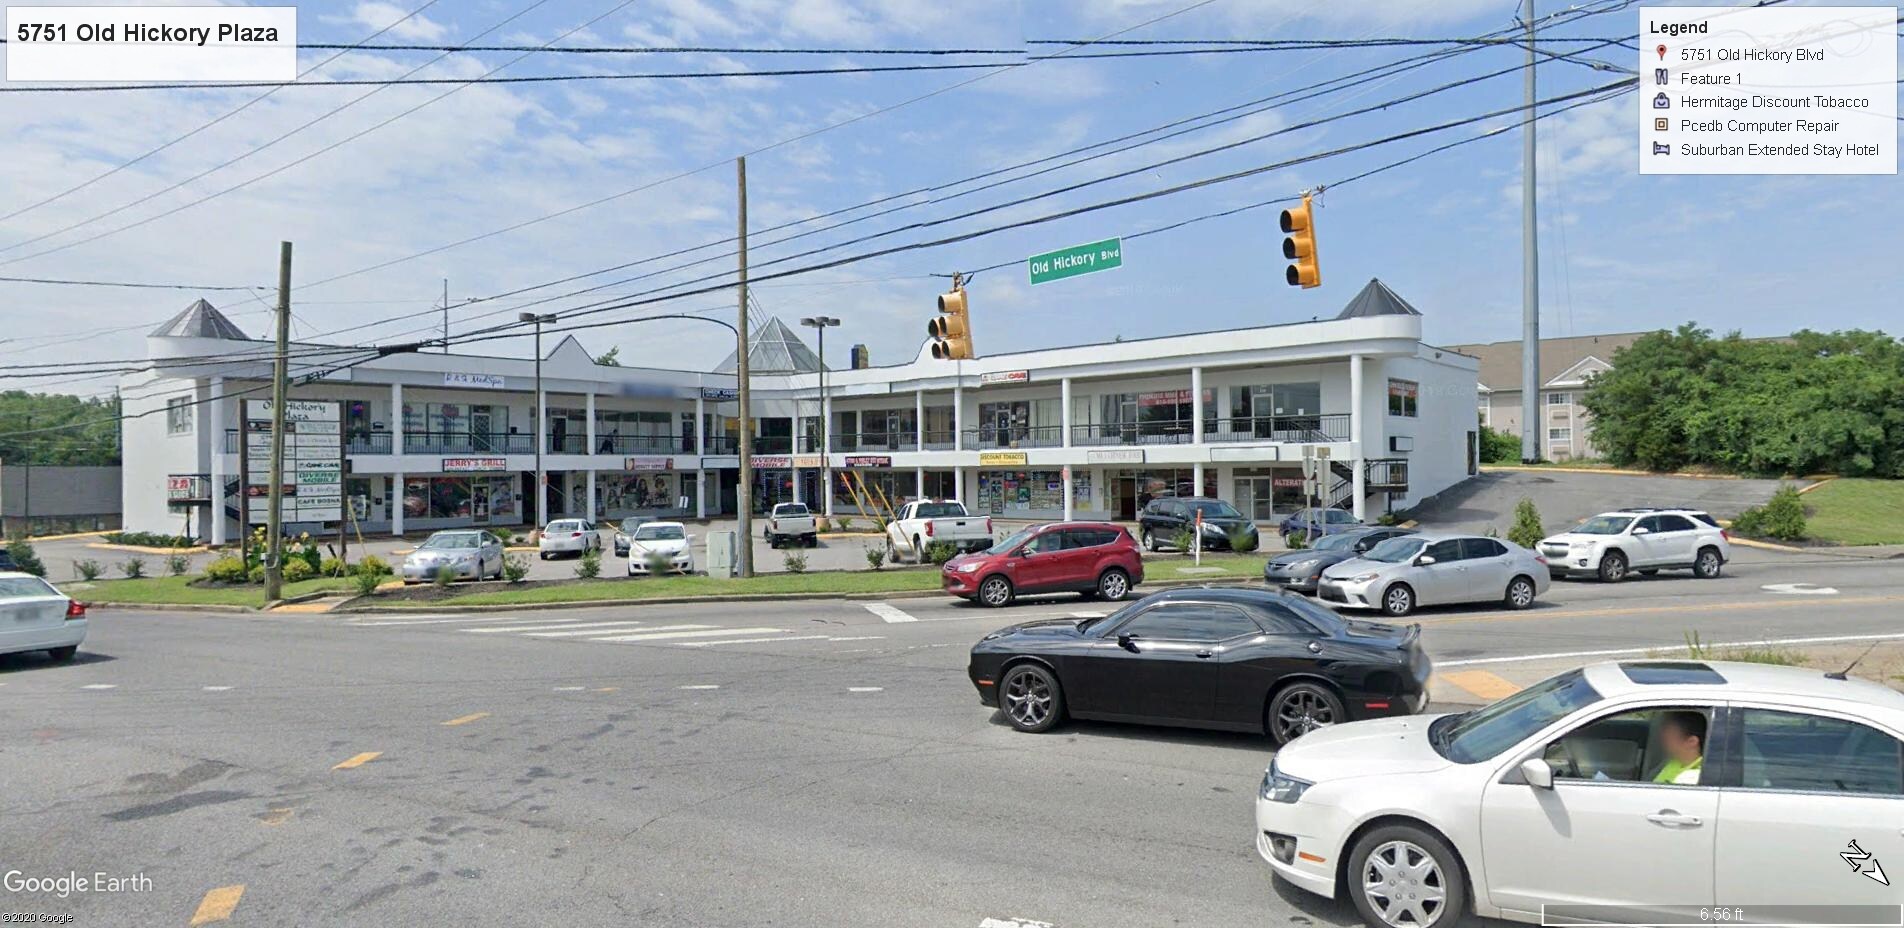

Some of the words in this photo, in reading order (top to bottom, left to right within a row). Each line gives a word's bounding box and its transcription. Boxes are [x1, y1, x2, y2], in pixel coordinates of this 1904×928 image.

[1032, 260, 1049, 275] Old
[1053, 252, 1095, 270] Hickory
[1101, 249, 1119, 260] Blvd
[481, 459, 505, 467] GRILL
